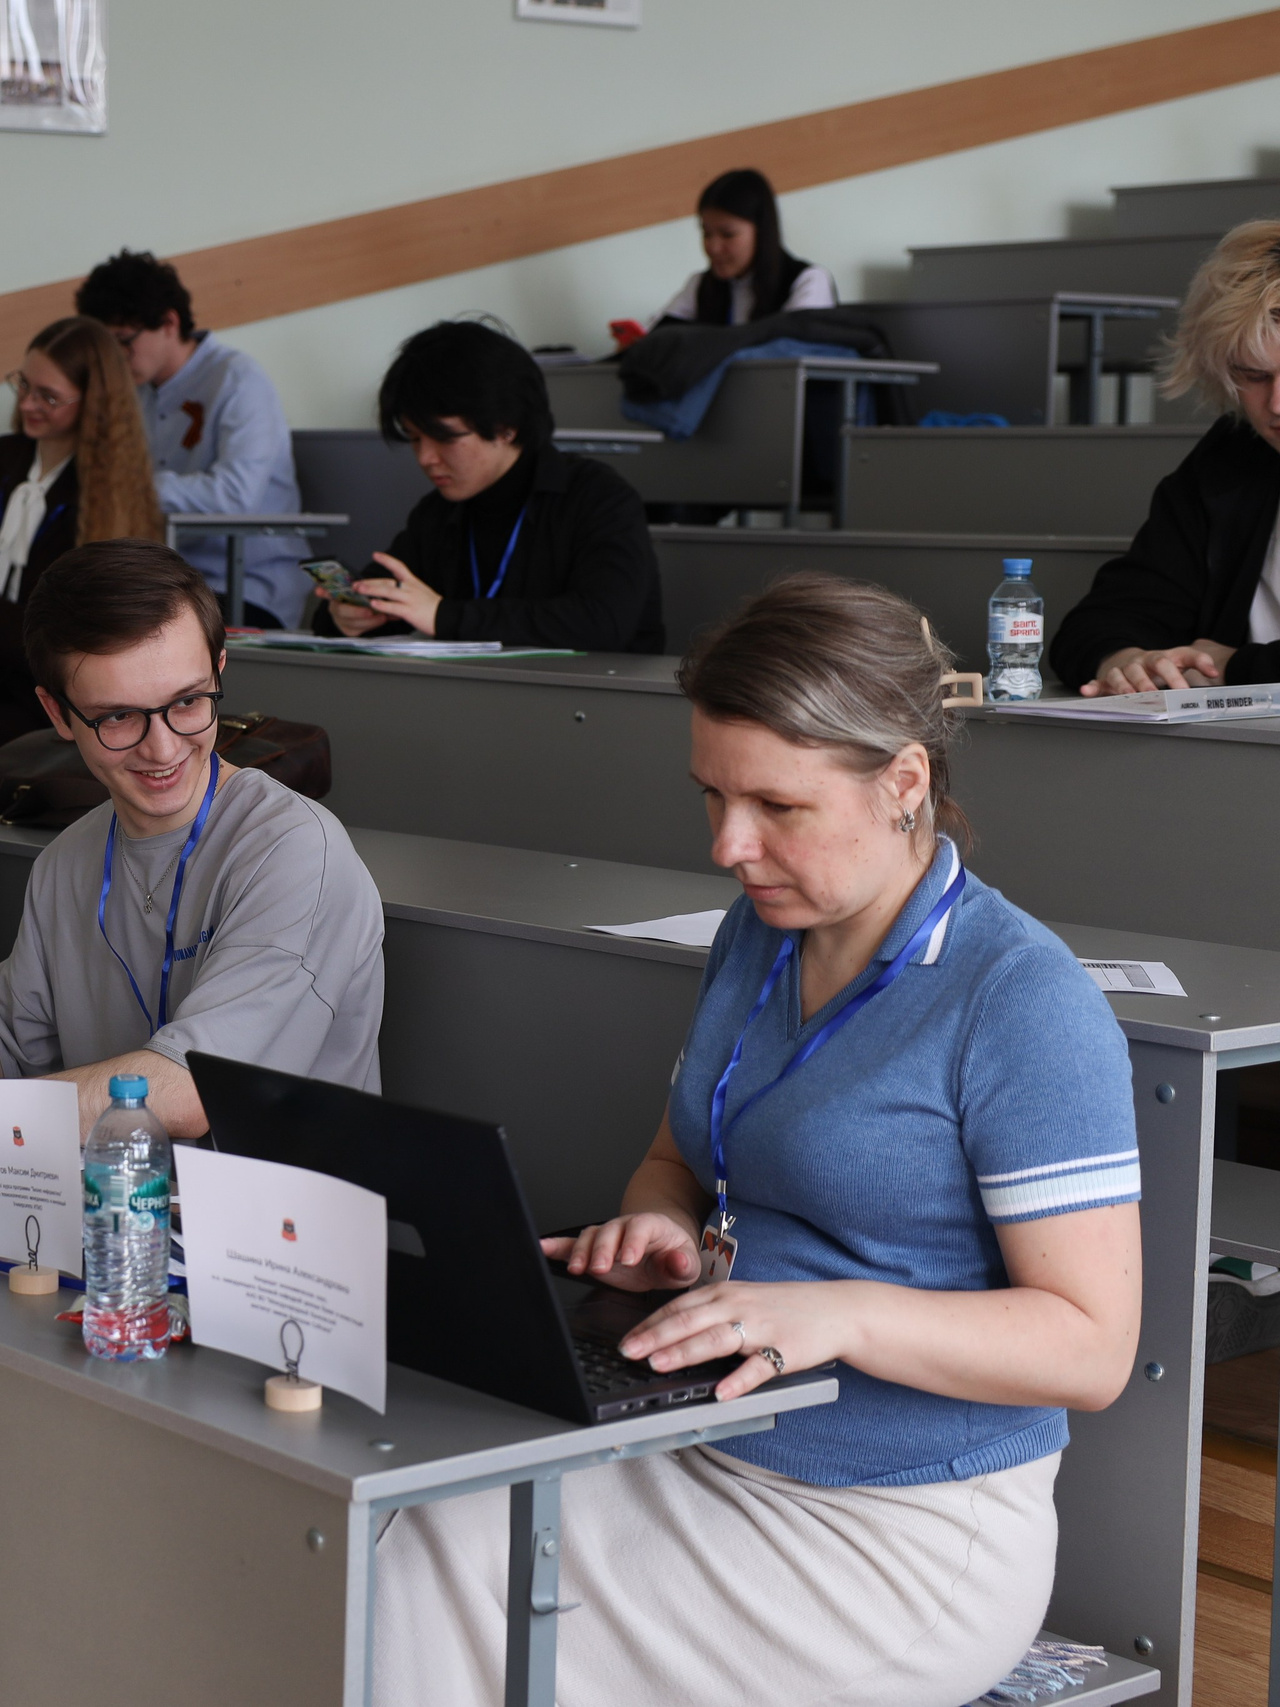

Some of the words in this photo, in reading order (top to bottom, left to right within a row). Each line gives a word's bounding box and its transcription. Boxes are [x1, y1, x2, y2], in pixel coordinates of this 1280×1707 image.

[1206, 698, 1225, 709] RING
[1226, 697, 1253, 708] BINDER
[7, 1166, 30, 1177] Максим
